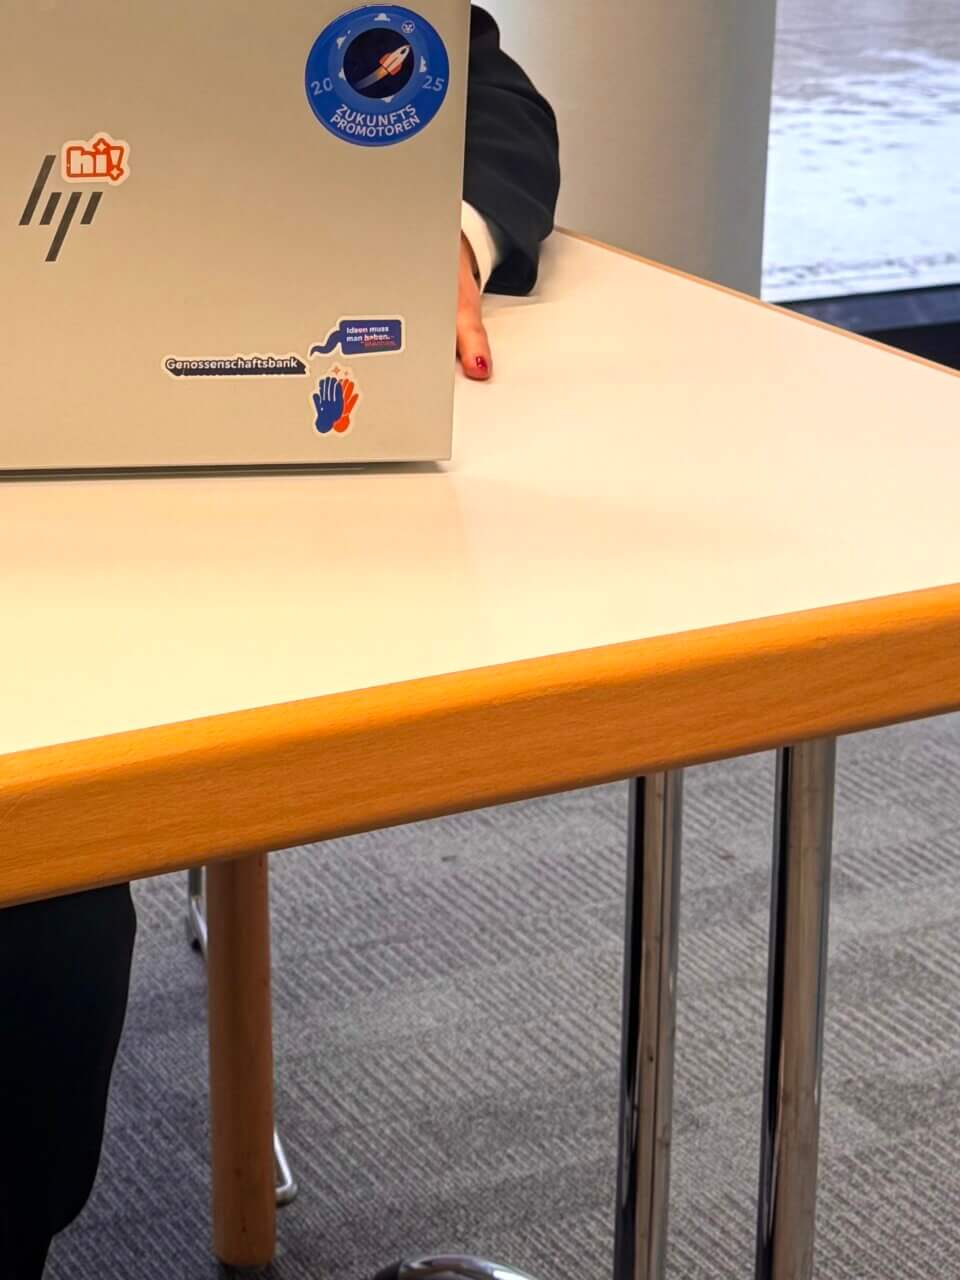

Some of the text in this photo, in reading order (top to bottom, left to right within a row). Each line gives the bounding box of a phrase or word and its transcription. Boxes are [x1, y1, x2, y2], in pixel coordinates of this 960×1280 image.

[311, 75, 444, 95] 20 25
[330, 114, 420, 137] PROMOTOREN
[336, 104, 416, 126] ZUKUNFTS
[67, 138, 124, 181] hi!
[166, 357, 298, 370] Genossenschaftsbank
